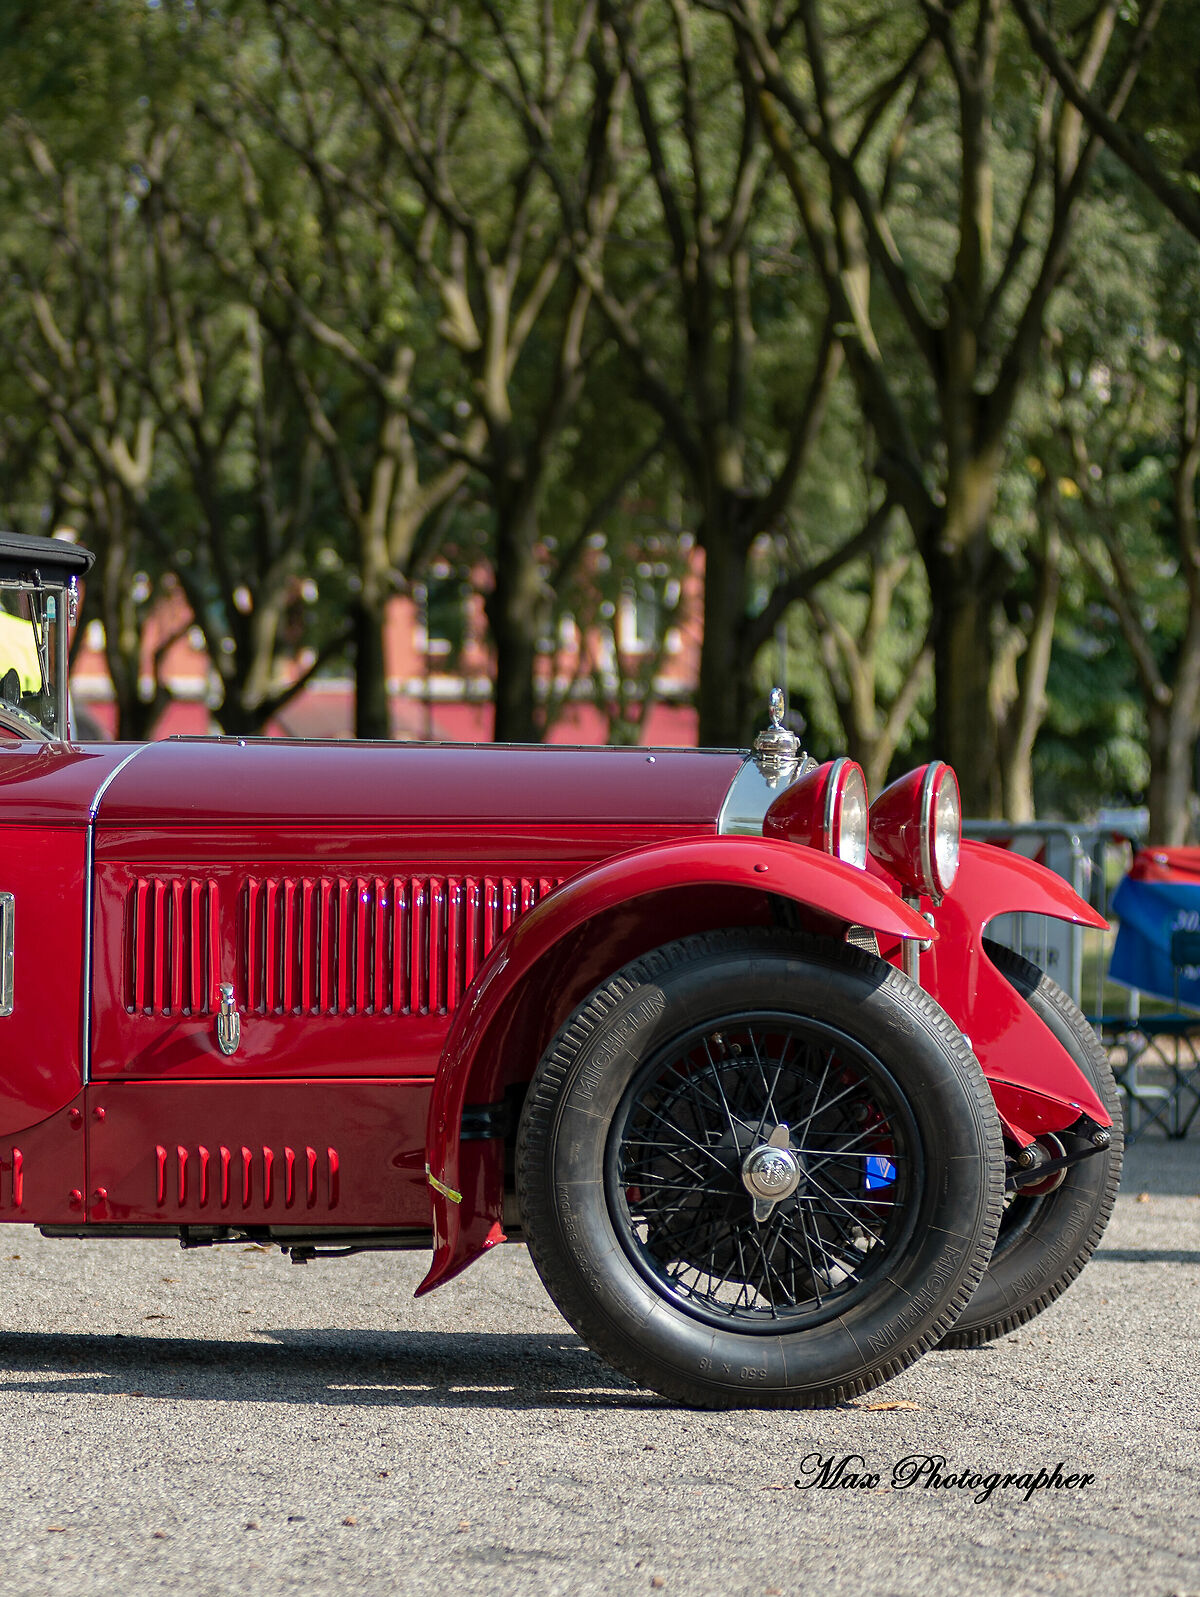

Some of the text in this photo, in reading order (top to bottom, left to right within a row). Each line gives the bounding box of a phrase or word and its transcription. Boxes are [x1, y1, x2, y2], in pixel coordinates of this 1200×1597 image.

[574, 990, 668, 1101] MICHELIN
[866, 1243, 962, 1354] MICHELIN
[1010, 1199, 1092, 1298] MICHELIN
